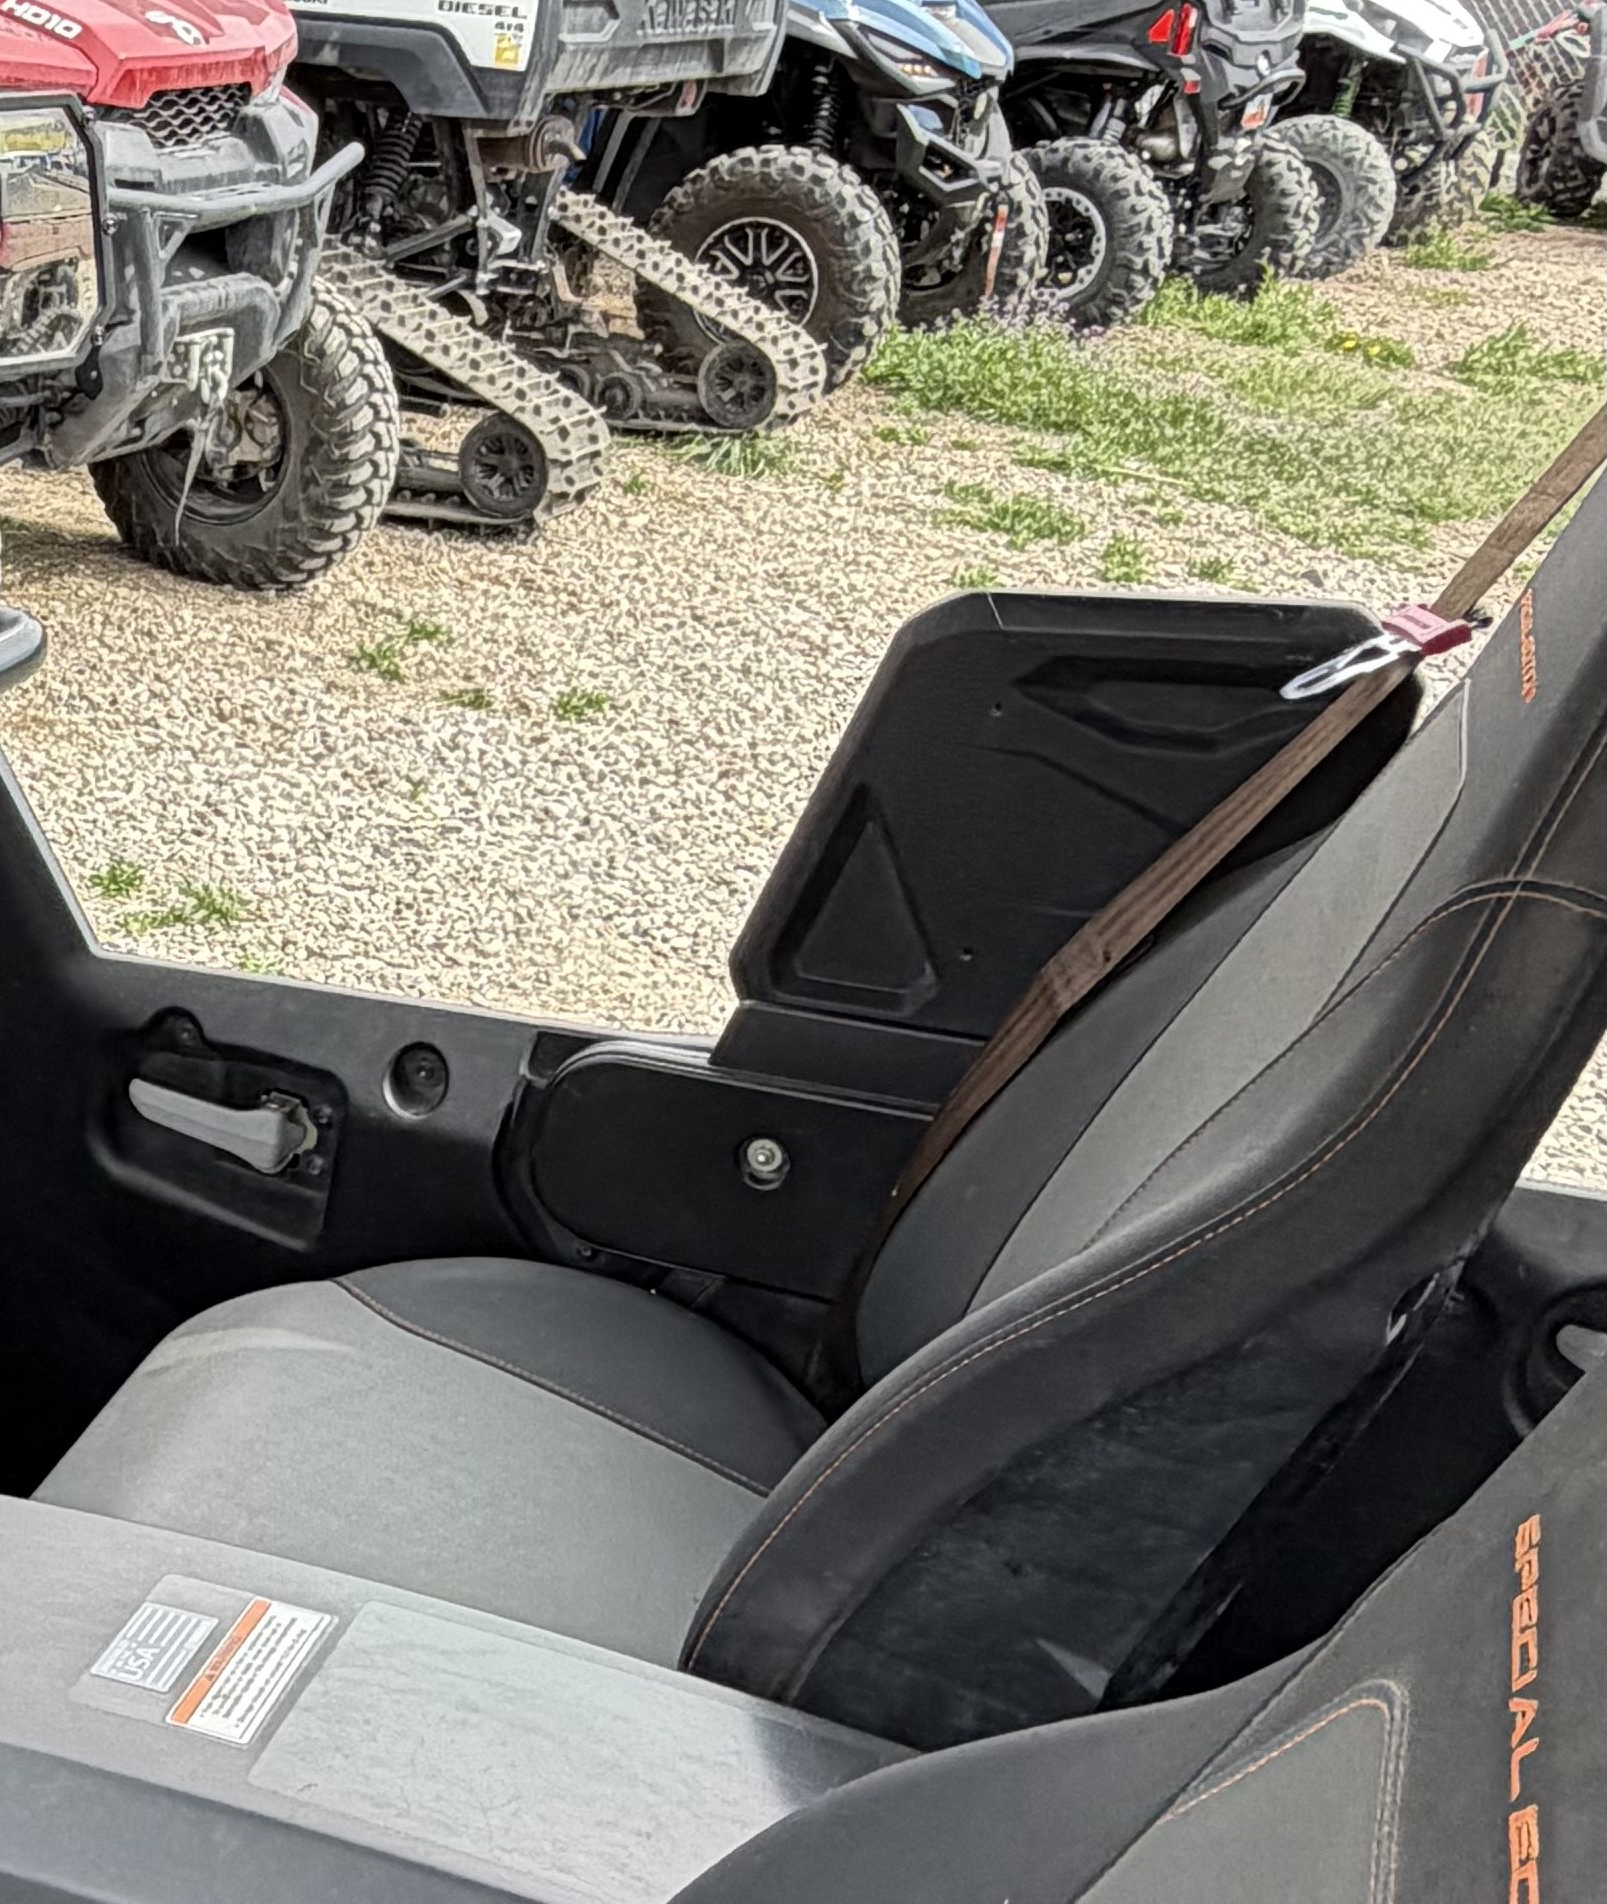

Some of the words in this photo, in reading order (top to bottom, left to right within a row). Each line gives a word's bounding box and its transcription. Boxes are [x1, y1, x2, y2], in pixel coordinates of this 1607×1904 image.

[494, 20, 525, 33] 4x4
[119, 1646, 160, 1680] USA
[1507, 1513, 1542, 1803] SPECIAL
